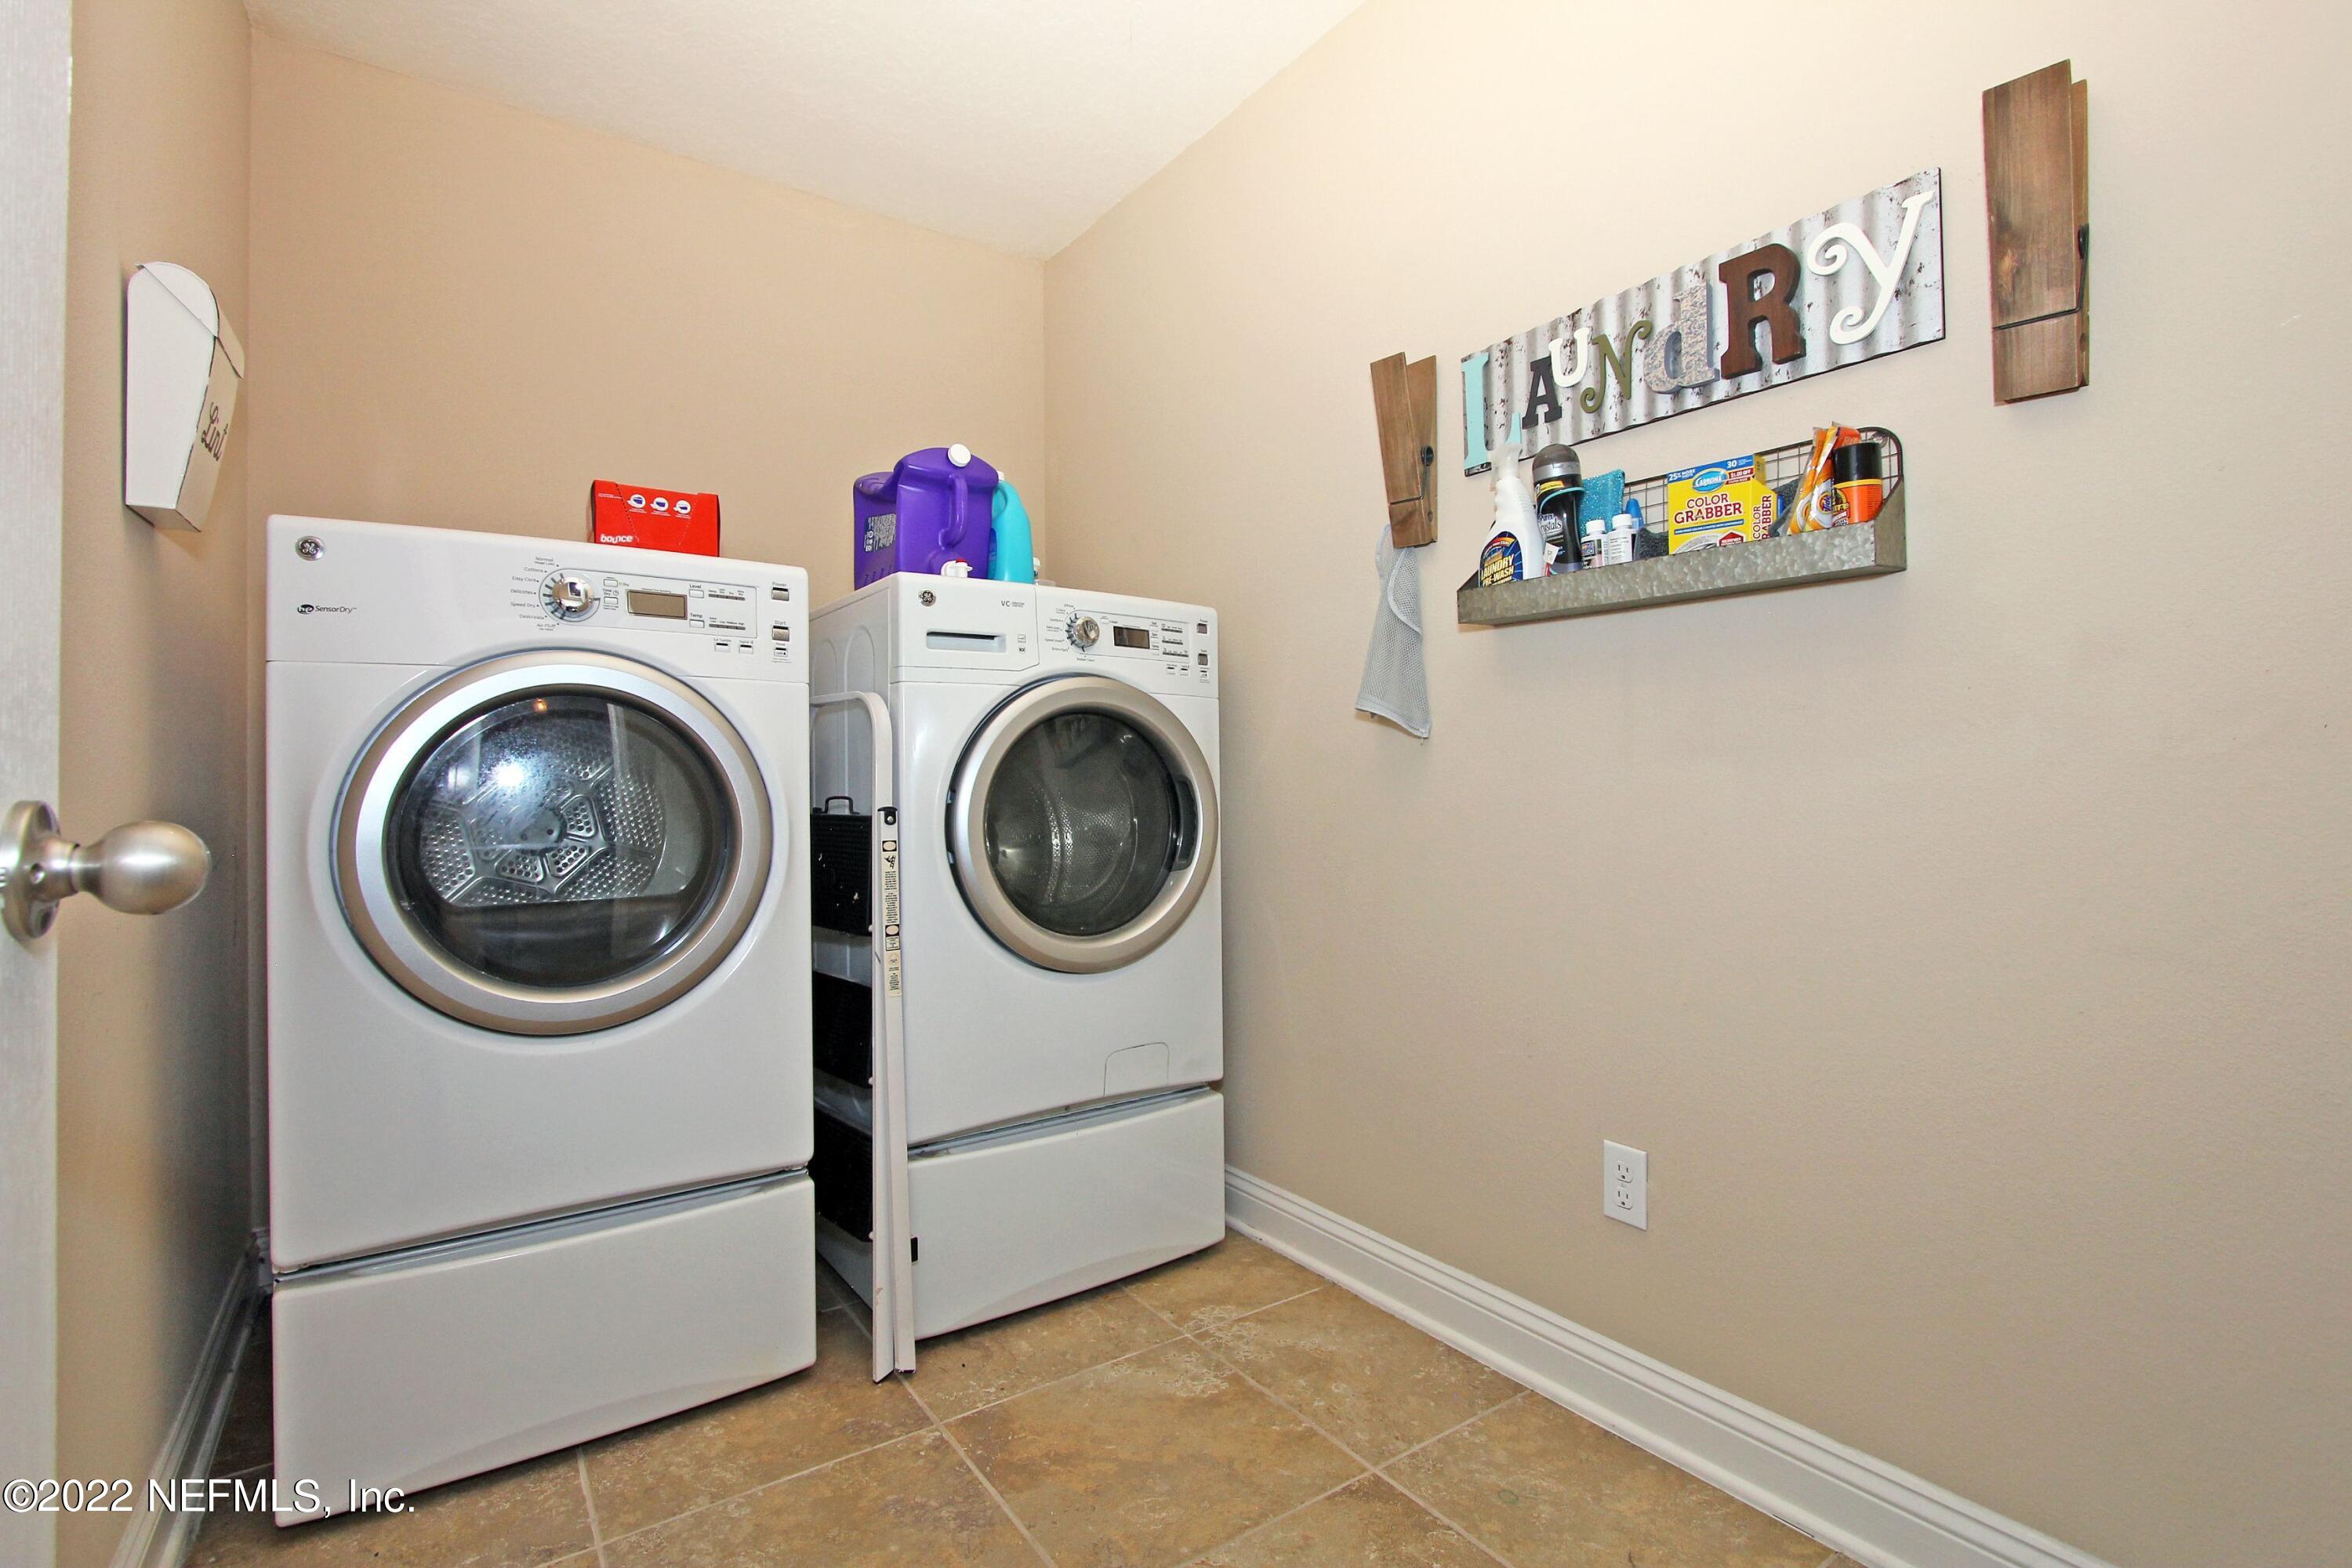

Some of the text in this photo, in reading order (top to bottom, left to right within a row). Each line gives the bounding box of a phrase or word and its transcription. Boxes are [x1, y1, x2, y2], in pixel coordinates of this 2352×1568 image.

[1726, 460, 1737, 469] 30
[1686, 493, 1729, 510] COLOR
[1674, 503, 1742, 524] GRABBER
[1752, 506, 1761, 539] COLOR
[600, 534, 633, 544] bounce
[1481, 554, 1514, 581] LAUNDRY
